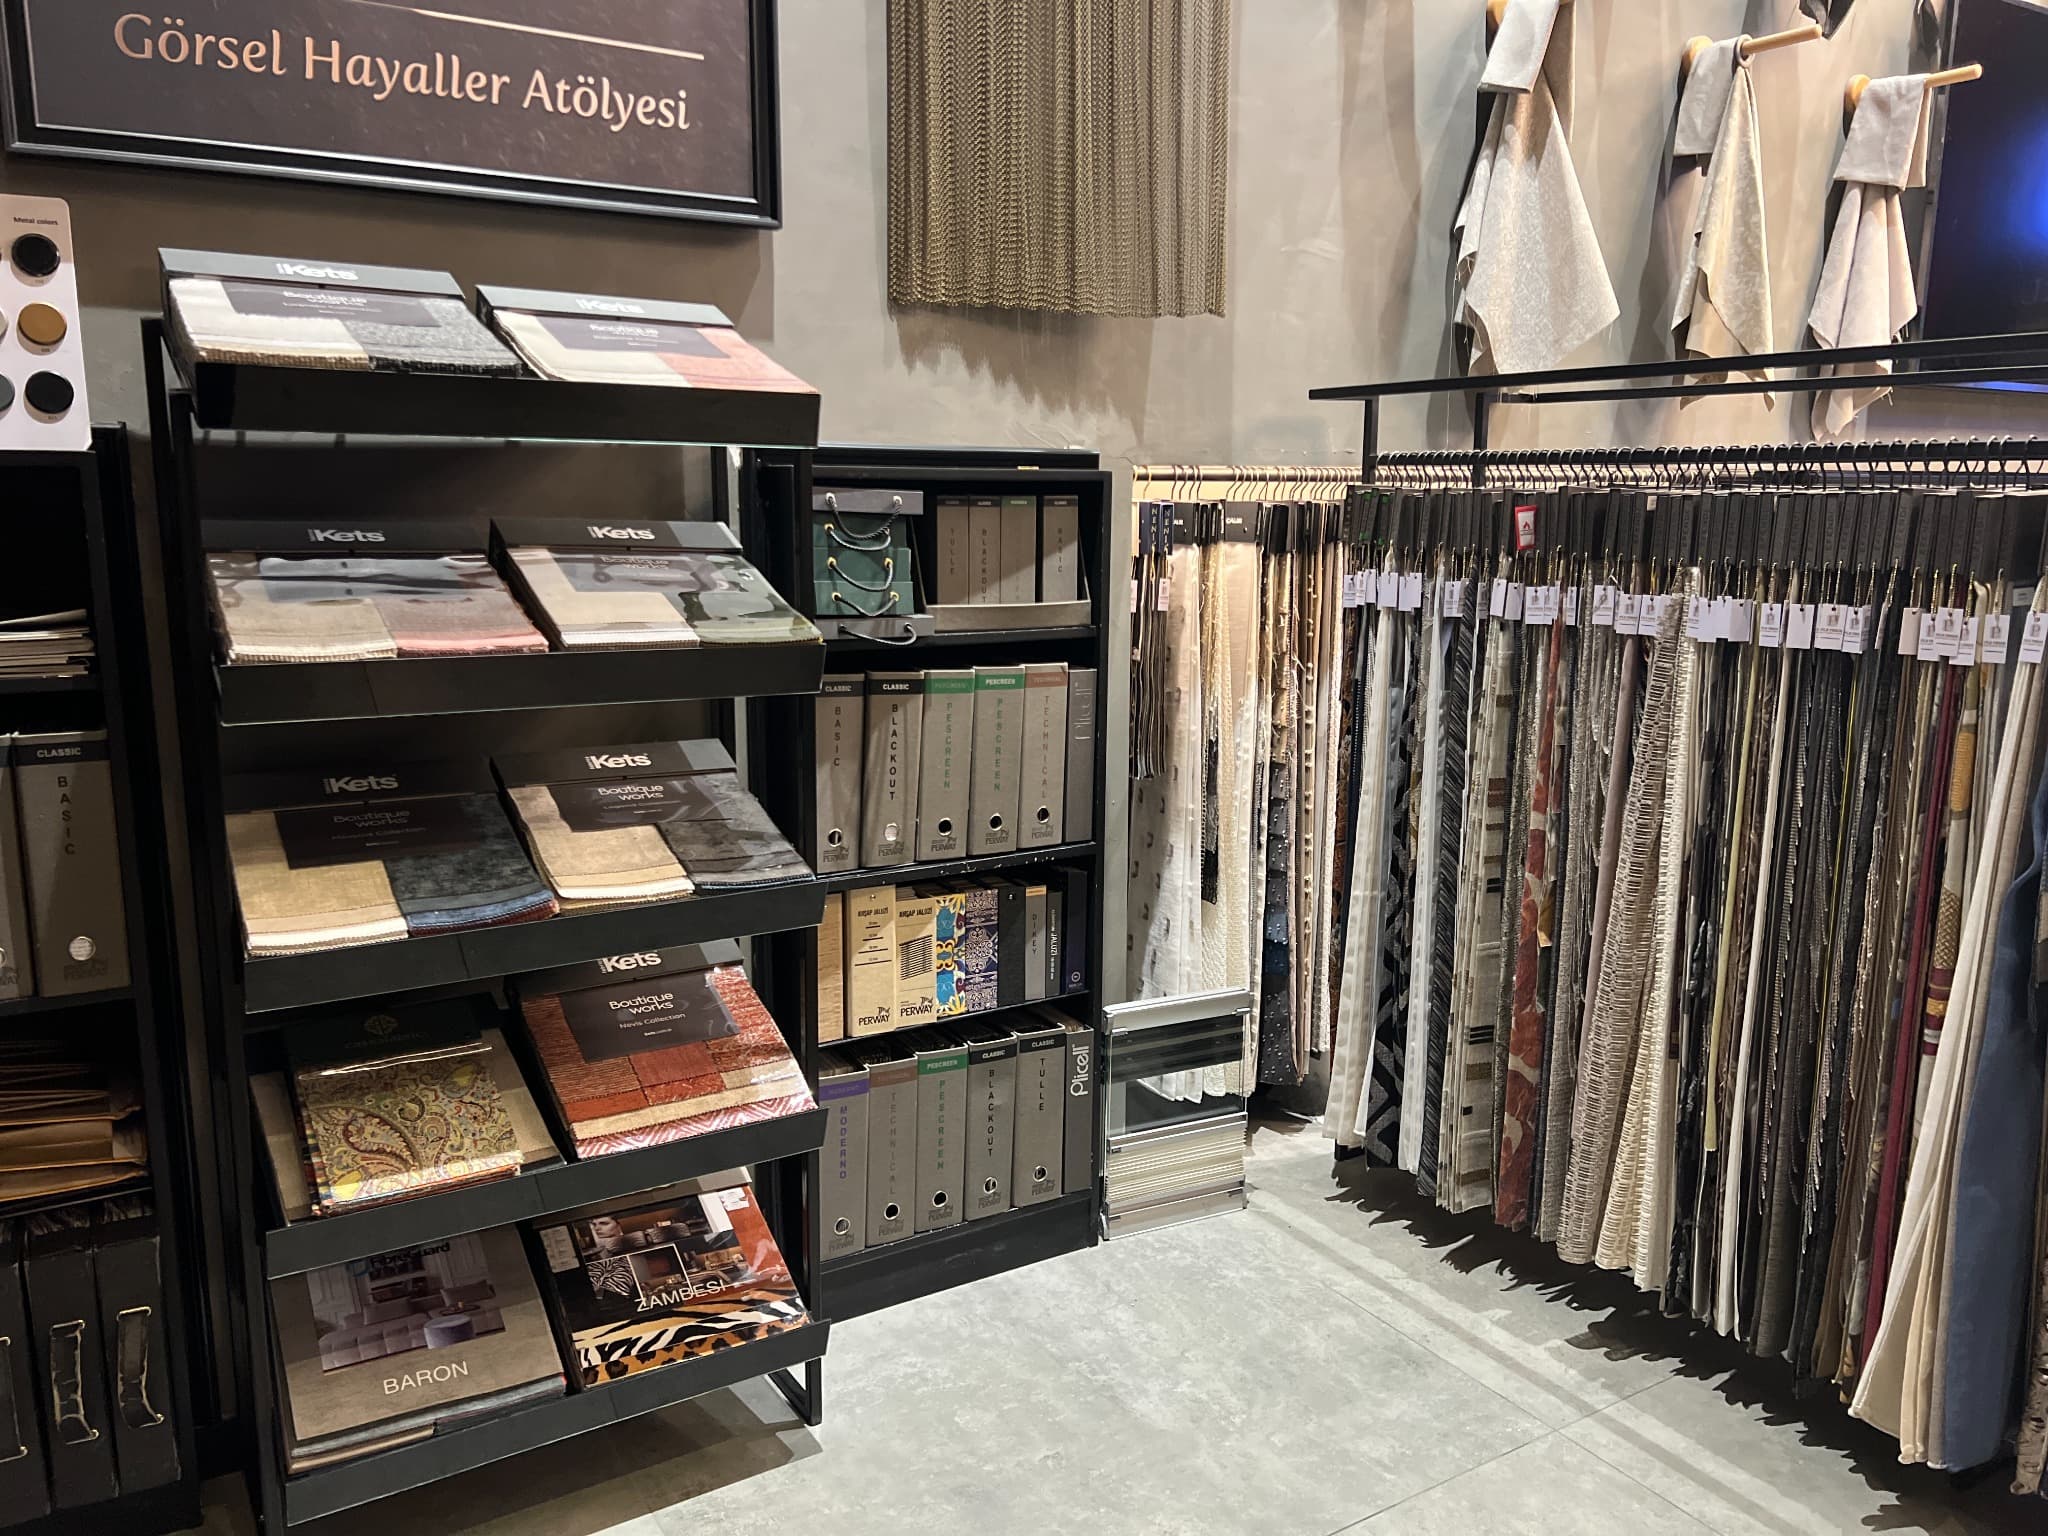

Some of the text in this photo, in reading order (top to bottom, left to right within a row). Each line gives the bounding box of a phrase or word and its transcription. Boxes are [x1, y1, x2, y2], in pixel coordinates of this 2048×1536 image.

[114, 13, 691, 132] Görsel Hayaller Atölyesi
[825, 684, 852, 692] CLASSIC
[882, 682, 910, 691] CLASSIC
[832, 706, 842, 767] BASIC
[36, 747, 82, 759] CLASSIC
[889, 703, 898, 801] BLACKOUT
[1040, 695, 1049, 799] TECHNICAL
[597, 784, 664, 797] Boutique
[618, 792, 664, 801] works
[57, 775, 76, 855] BASIC
[602, 952, 662, 973] Kets
[608, 993, 674, 1010] Boutique
[628, 1001, 674, 1015] works
[901, 1004, 934, 1017] PERWAY
[643, 1013, 686, 1025] Collection
[858, 1014, 890, 1026] PERWAY
[1031, 1038, 1055, 1047] CLASSIC
[982, 1050, 1006, 1059] CLASSIC
[1070, 1044, 1089, 1096] Plicell
[987, 1069, 995, 1157] BLACKOUT
[839, 1105, 848, 1180] MODERNO
[889, 1092, 897, 1196] TECHNICAL
[634, 1279, 727, 1312] ZAMBESI
[383, 1360, 469, 1395] BARON
